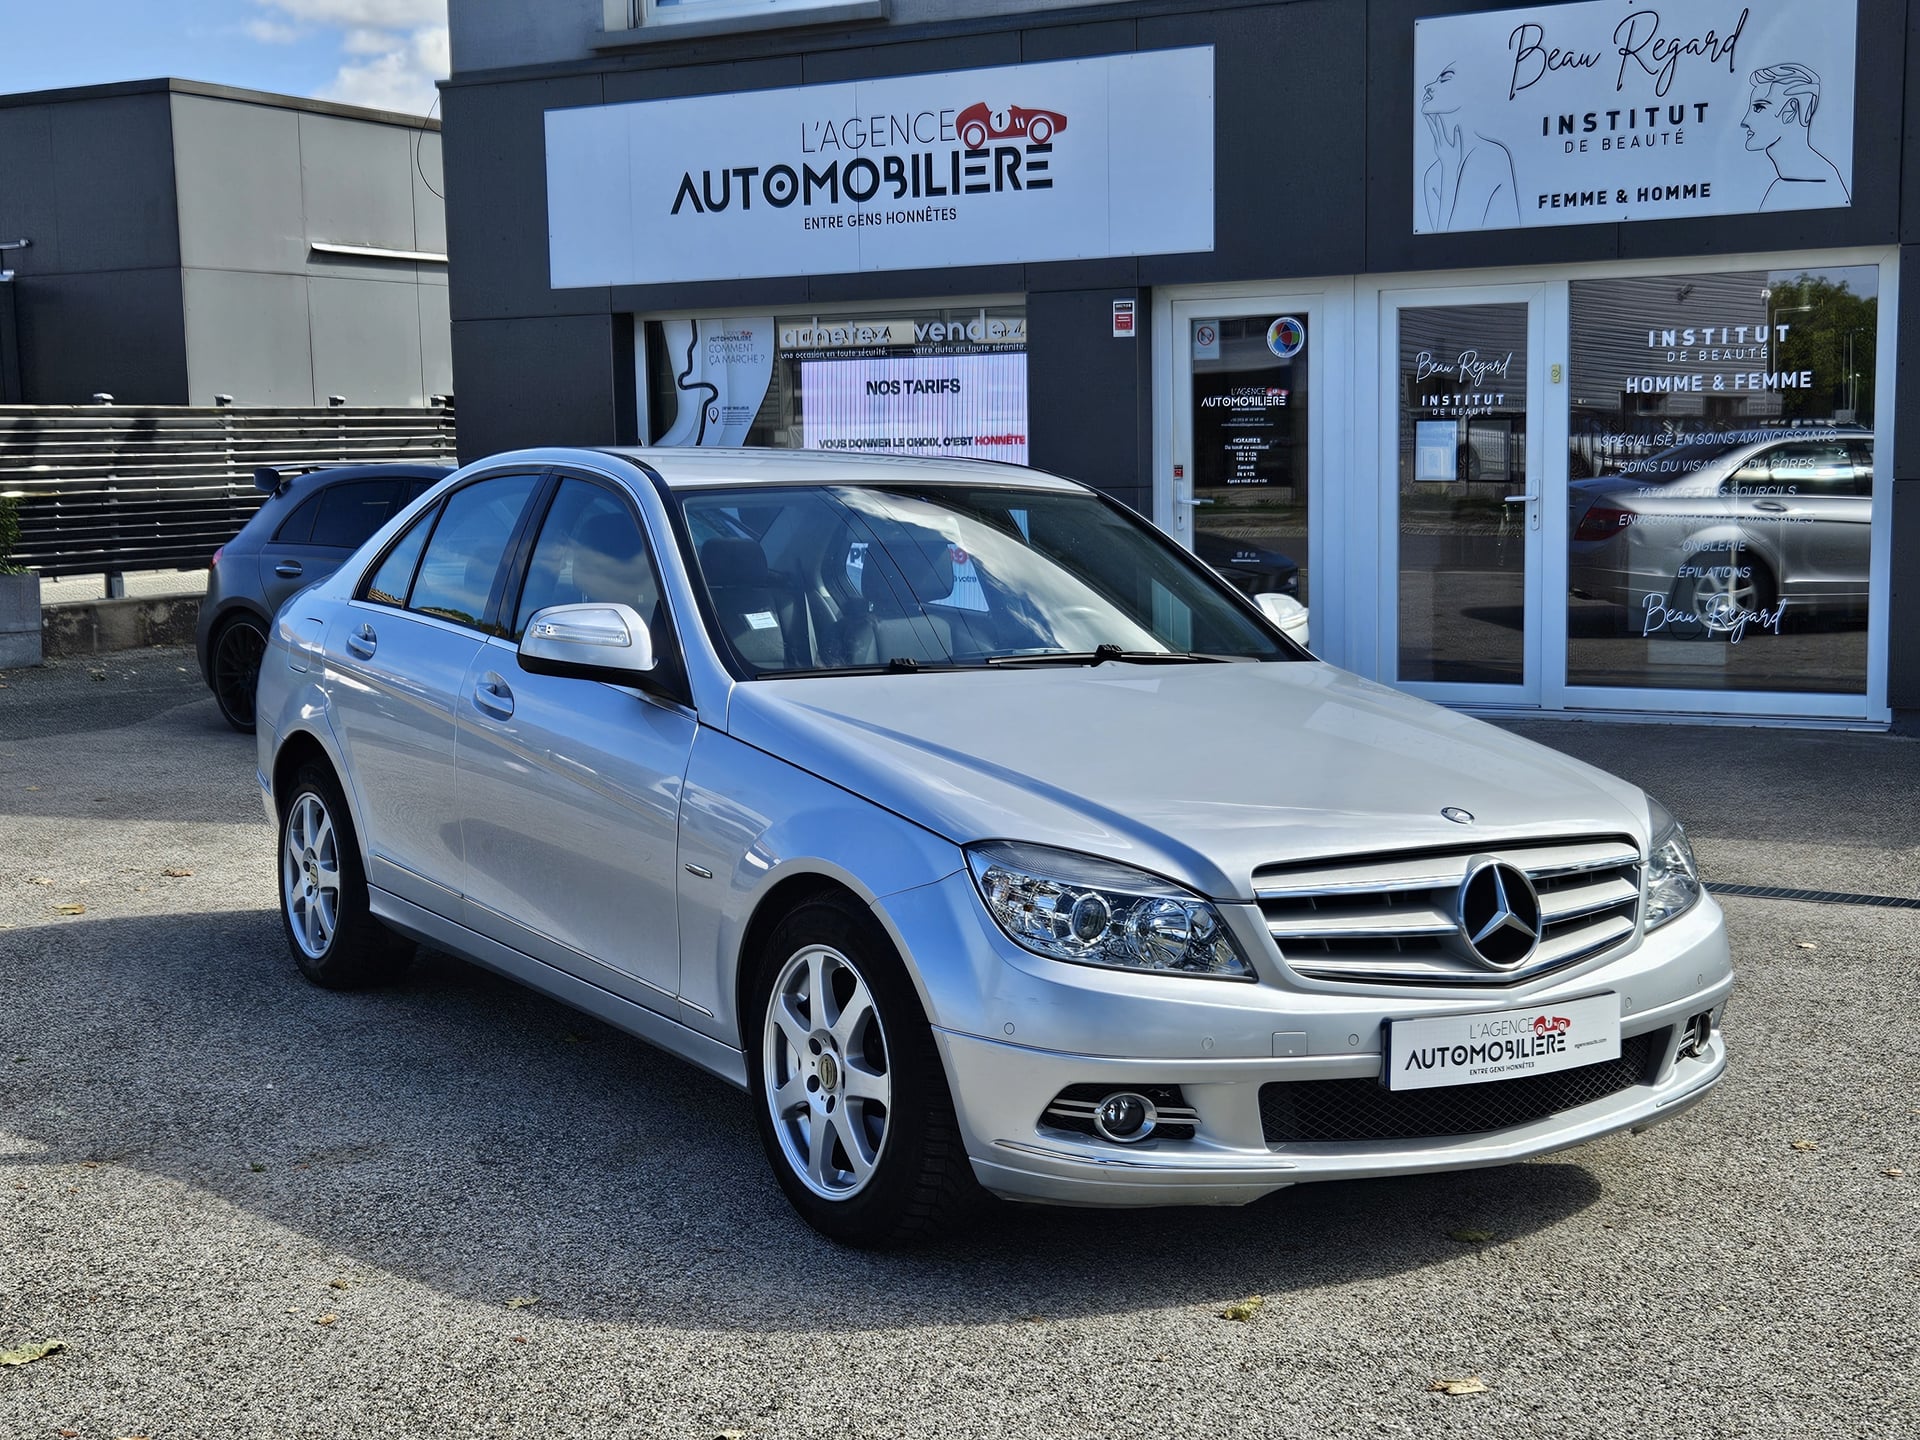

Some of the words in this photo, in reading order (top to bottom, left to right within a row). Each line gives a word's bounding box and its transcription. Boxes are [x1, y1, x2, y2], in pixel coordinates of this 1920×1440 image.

[1509, 23, 1601, 100] Beau
[1613, 7, 1749, 97] Regard
[1542, 102, 1710, 137] INSTITUT
[801, 109, 956, 153] L'AGENCE
[1564, 139, 1589, 154] DE
[1602, 128, 1684, 151] BEAUTÉ
[1538, 189, 1608, 209] FEMME
[1615, 189, 1628, 204] &
[1637, 183, 1712, 203] HOMME
[804, 216, 843, 230] ENTRE
[847, 212, 882, 227] GENS
[886, 206, 957, 225] HONNÊTES
[783, 316, 890, 348] achetez
[914, 309, 1023, 342] vendez
[1649, 324, 1790, 347] INSTITUT
[708, 344, 753, 354] COMMENT
[708, 355, 720, 366] ÇA
[722, 354, 758, 364] MARCHE
[761, 354, 765, 363] ?
[1667, 351, 1687, 362] DE
[1699, 345, 1768, 361] BEAUTÉ
[1416, 351, 1454, 383] Beau
[1458, 350, 1512, 387] Regard
[866, 380, 901, 396] NOS
[904, 378, 961, 395] TARIFS
[1626, 375, 1703, 393] HOMME
[1712, 374, 1725, 391] &
[1734, 371, 1812, 389] FEMME
[1421, 394, 1504, 406] INSTITUT
[1432, 408, 1445, 416] DE
[1451, 406, 1493, 416] BEAUTÉ
[819, 439, 847, 449] VOUS
[849, 438, 892, 448] DONNER
[893, 438, 905, 447] LE
[975, 433, 1026, 446] HONNÊTE
[1675, 433, 1694, 445] EN
[1696, 432, 1735, 445] SOINS
[1737, 430, 1837, 444] AMINCISSANTS
[1619, 461, 1658, 473] SOINS
[1660, 461, 1680, 472] DU
[1770, 458, 1815, 470] CORPS
[1681, 540, 1746, 552] ONGLERIE
[1677, 566, 1751, 579] ÉPILATIONS
[1642, 593, 1700, 637] Beau
[1705, 592, 1787, 645] Regard
[1470, 1017, 1534, 1039] L'AGENCE
[1469, 1067, 1488, 1075] ENTRE
[1490, 1065, 1505, 1073] GENS
